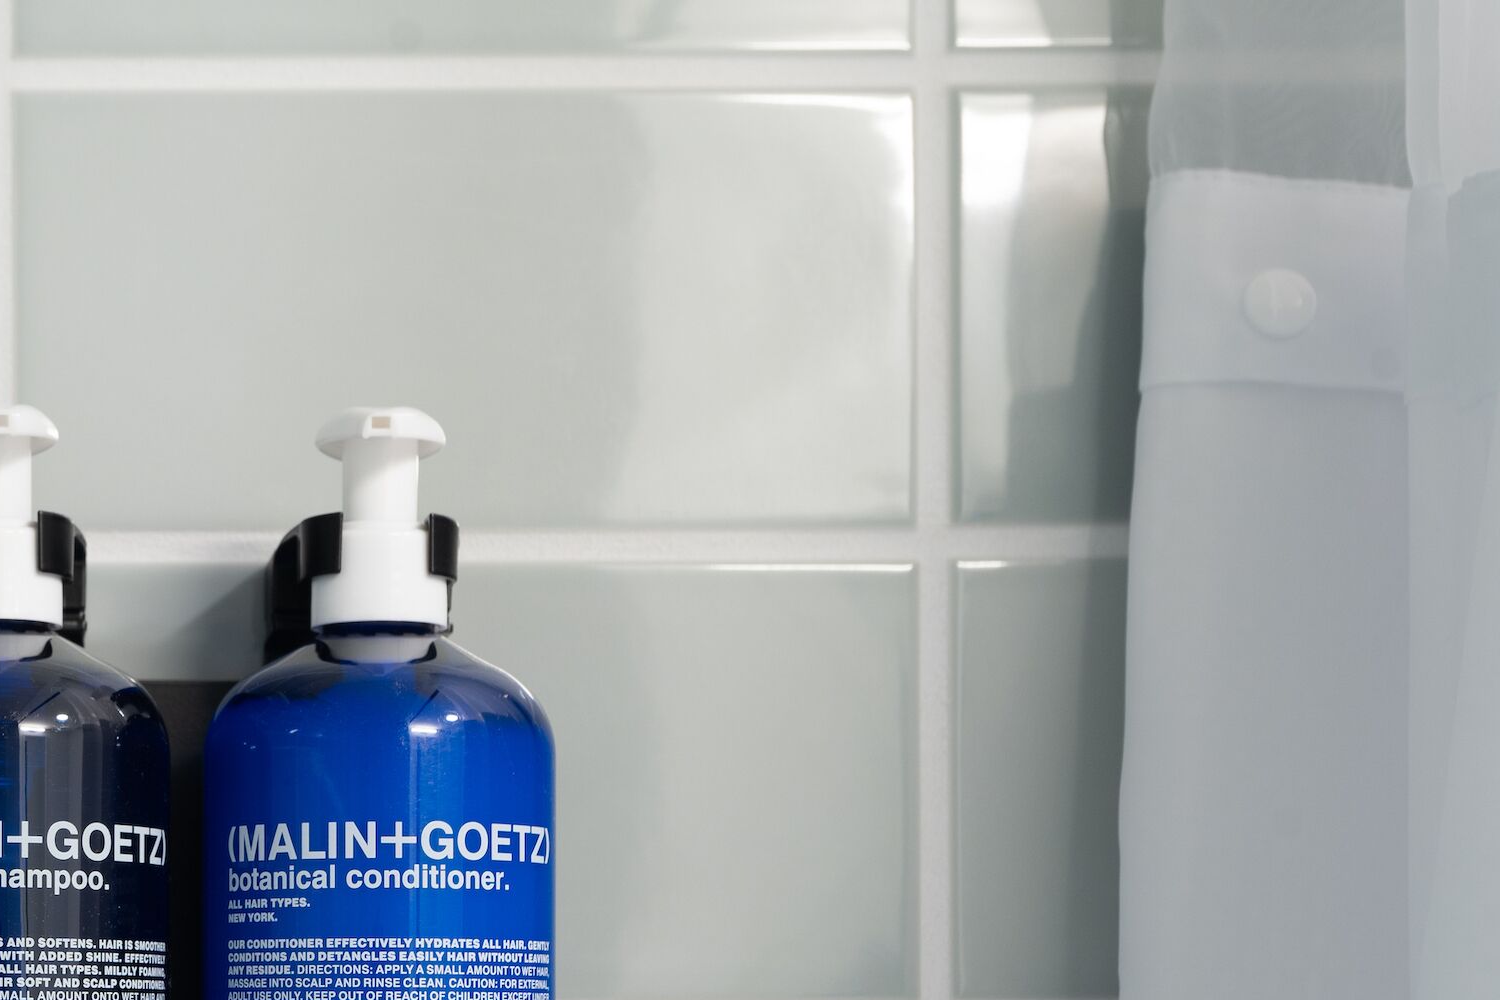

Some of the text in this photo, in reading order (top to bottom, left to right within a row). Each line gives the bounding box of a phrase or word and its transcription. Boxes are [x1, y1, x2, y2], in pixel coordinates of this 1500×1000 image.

[228, 820, 550, 865] (MALIN+GOETZ)
[228, 864, 510, 893] botanical conditioner.
[228, 897, 310, 910] ALL HAIR TYPES.
[228, 912, 278, 923] NEW YORK.
[6, 937, 35, 948] AND
[37, 938, 96, 949] SOFTENS.
[98, 939, 123, 950] HAIR
[124, 940, 133, 950] IS
[228, 939, 245, 950] OUR
[246, 938, 323, 950] CONDITIONER
[326, 938, 412, 948] EFFECTIVELY
[415, 938, 480, 949] HYDRATES
[482, 939, 502, 950] ALL
[502, 939, 527, 950] HAIR.
[38, 951, 82, 962] ADDED
[85, 952, 122, 963] SHINE.
[228, 952, 287, 963] CONDITIONS
[288, 951, 315, 962] AND
[317, 951, 396, 962] DETANGLES
[398, 951, 444, 962] EASILY
[446, 952, 476, 962] HAIR
[477, 952, 523, 963] WITHOUT
[25, 964, 57, 975] HAIR
[59, 964, 102, 976] TYPES.
[104, 965, 138, 977] MILDLY
[253, 991, 272, 1000] USE
[273, 991, 303, 1000] ONLY.
[305, 991, 336, 1000] KEEP
[338, 991, 364, 1000] OUT
[365, 991, 383, 1000] OF
[385, 991, 427, 1000] REACH
